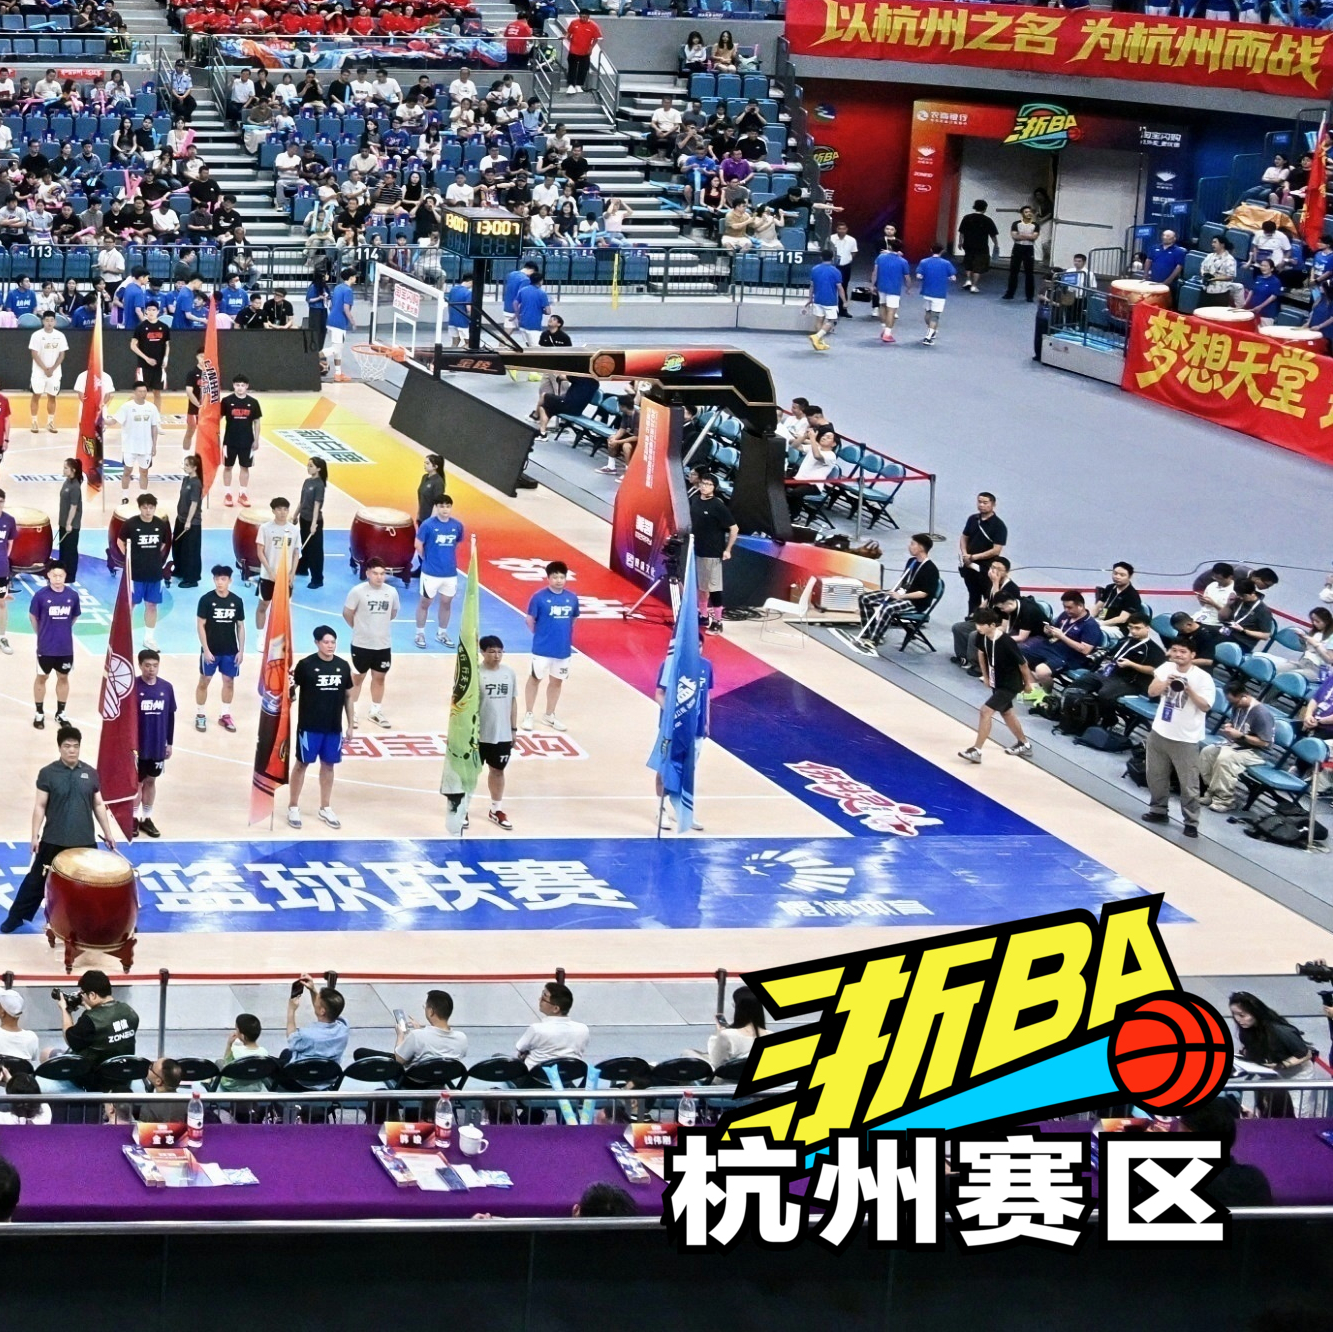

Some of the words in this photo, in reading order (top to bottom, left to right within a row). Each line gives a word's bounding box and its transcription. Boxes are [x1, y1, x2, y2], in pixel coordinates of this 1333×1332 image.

[1064, 16, 1332, 90] 为杭州而战
[1004, 114, 1077, 145] 浙BA
[29, 245, 53, 258] 113
[356, 247, 379, 261] 114
[777, 251, 804, 265] 115
[1135, 309, 1320, 419] 梦想天堂
[137, 534, 160, 545] 玉环
[435, 534, 457, 545] 海宁
[367, 600, 390, 612] 宁海
[550, 605, 573, 617] 海宁
[213, 607, 236, 619] 玉环
[316, 674, 343, 687] 玉环
[485, 683, 509, 696] 宁海
[779, 899, 936, 917] 橙狮体育
[152, 1134, 175, 1145] 金志
